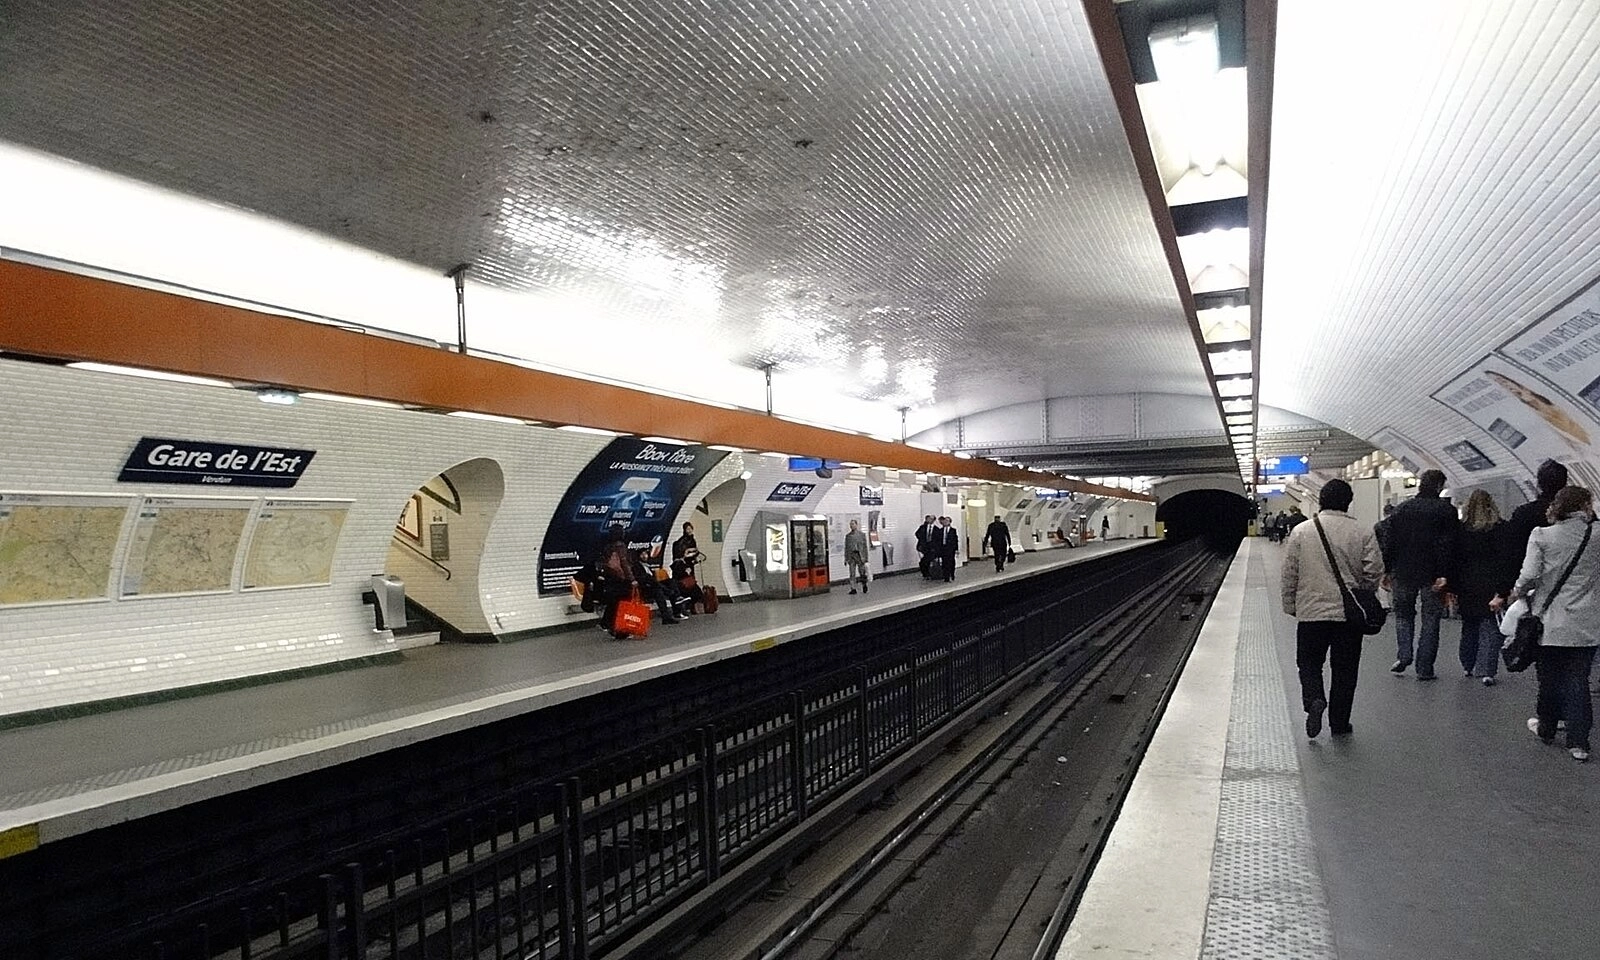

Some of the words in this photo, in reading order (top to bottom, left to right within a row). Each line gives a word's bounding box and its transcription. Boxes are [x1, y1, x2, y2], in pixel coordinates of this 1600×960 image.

[148, 444, 212, 467] Gare
[215, 449, 248, 470] de
[249, 451, 302, 473] l'Est
[609, 462, 620, 470] LA
